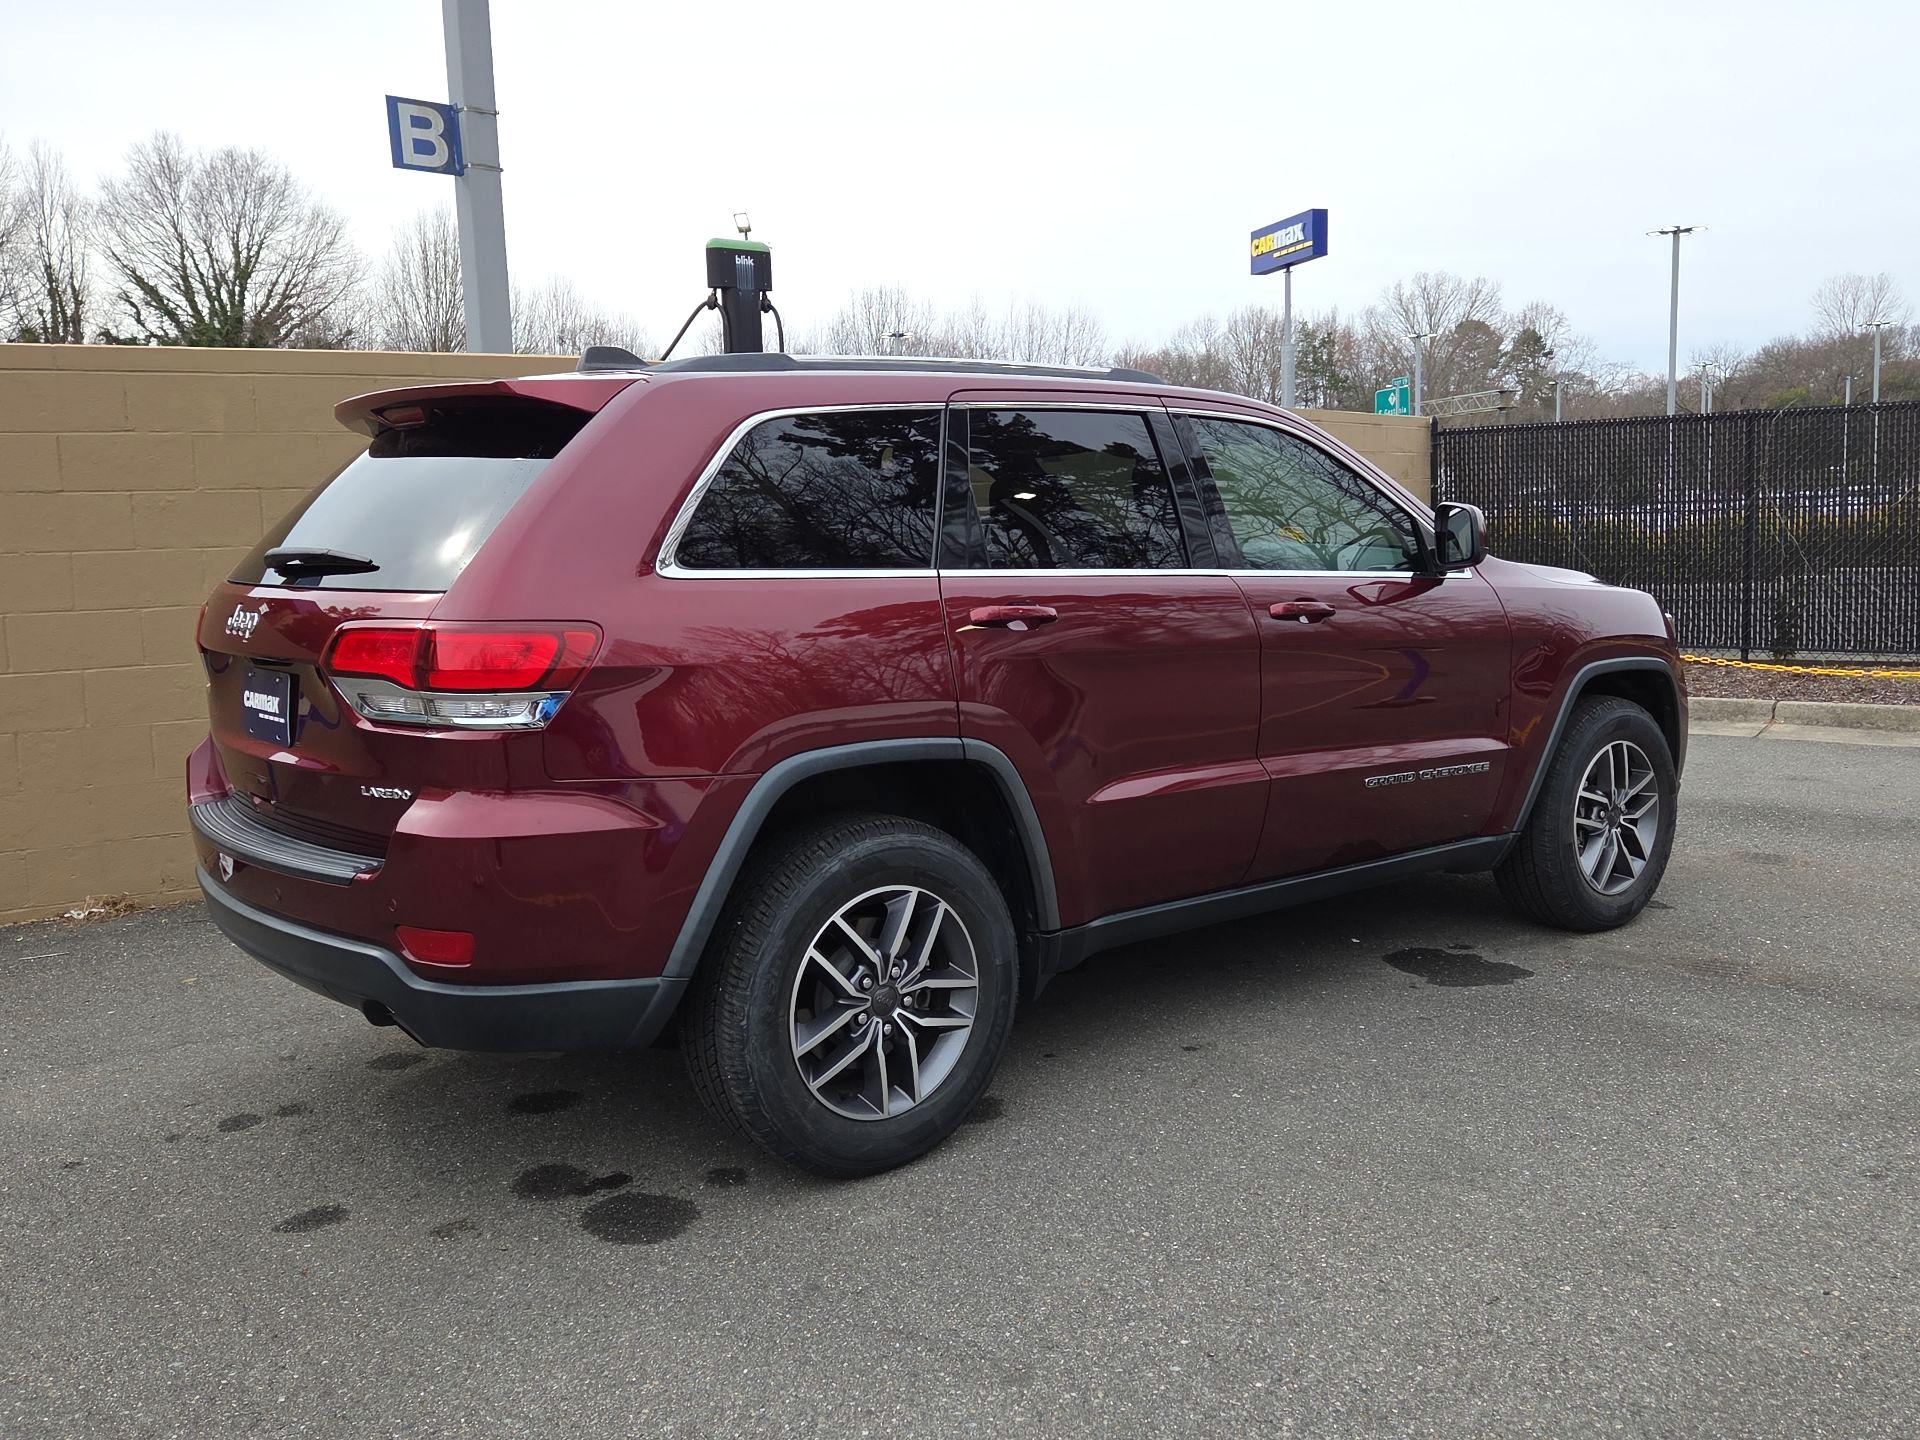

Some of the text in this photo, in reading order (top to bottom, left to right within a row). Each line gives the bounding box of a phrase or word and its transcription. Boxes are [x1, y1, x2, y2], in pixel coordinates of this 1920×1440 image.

[397, 102, 449, 168] B
[735, 254, 754, 266] blink
[227, 603, 260, 639] Jeep
[1364, 761, 1490, 788] GRAND CHEROKEE
[360, 785, 411, 800] LAREDO
